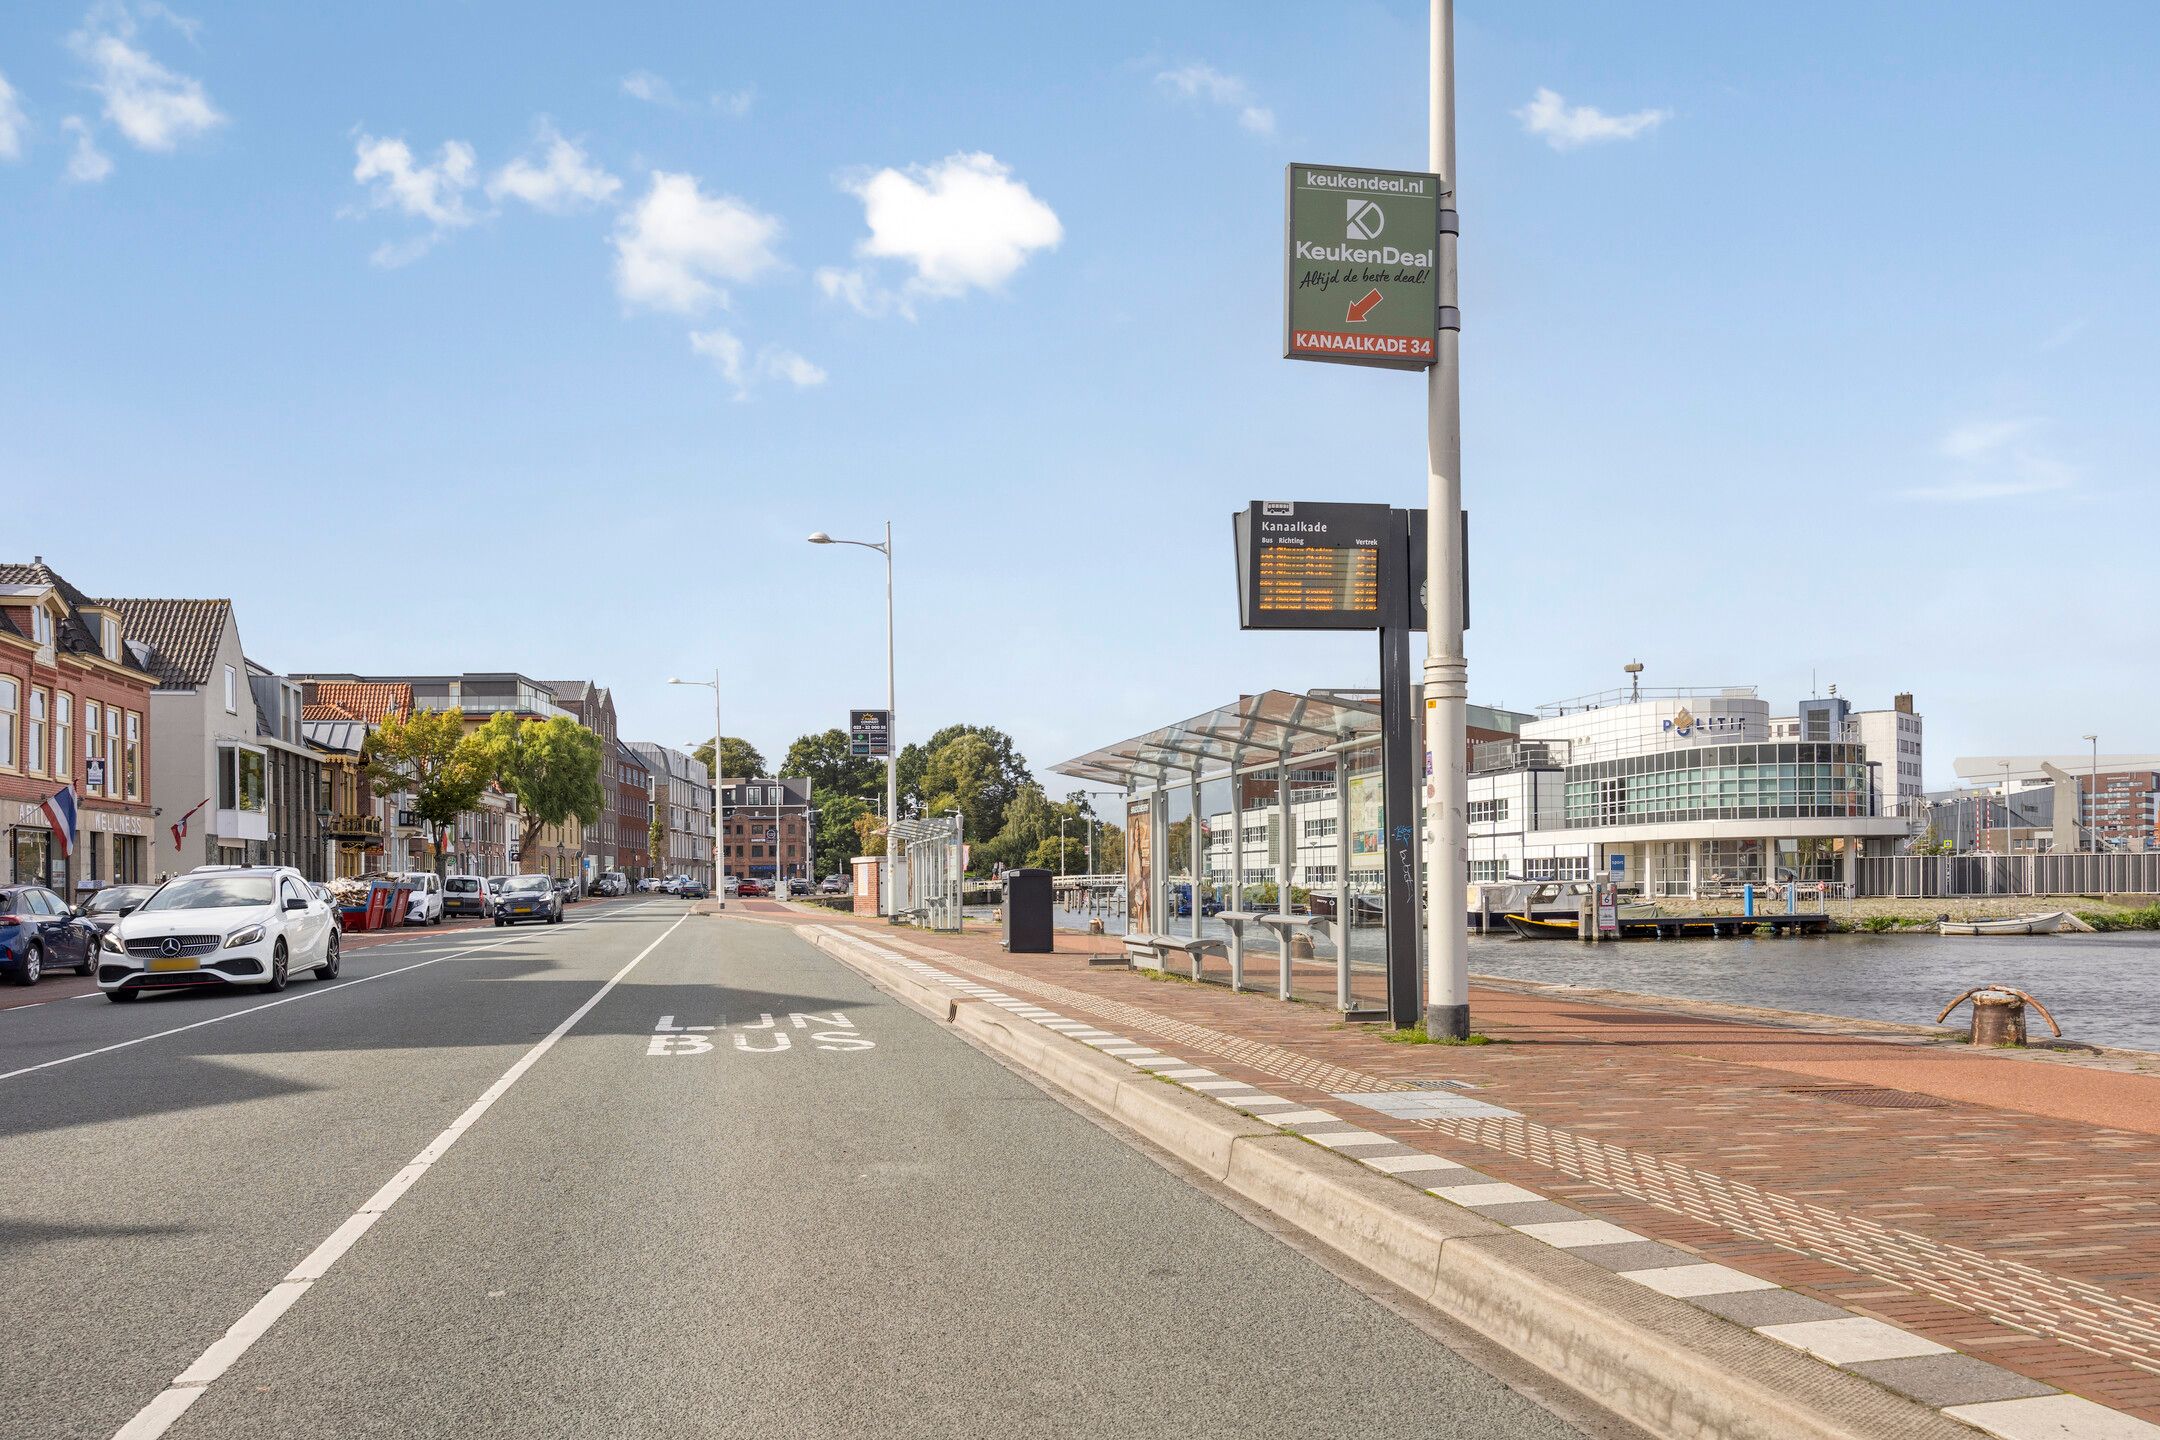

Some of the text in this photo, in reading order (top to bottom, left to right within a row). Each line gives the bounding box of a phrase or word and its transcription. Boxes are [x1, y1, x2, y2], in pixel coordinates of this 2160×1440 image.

[1306, 171, 1424, 194] keukendeal.nl
[1296, 240, 1433, 268] KeukenDeal
[1299, 268, 1429, 292] Altijd de beste deal!
[1296, 333, 1431, 354] KANAALKADE 34
[1261, 521, 1328, 533] Kanaalkade
[1278, 536, 1304, 546] Richting
[1355, 538, 1378, 546] Vertrek
[1663, 718, 1746, 736] POLITIE
[95, 811, 142, 834] WELLNESS
[646, 1032, 876, 1055] BUS
